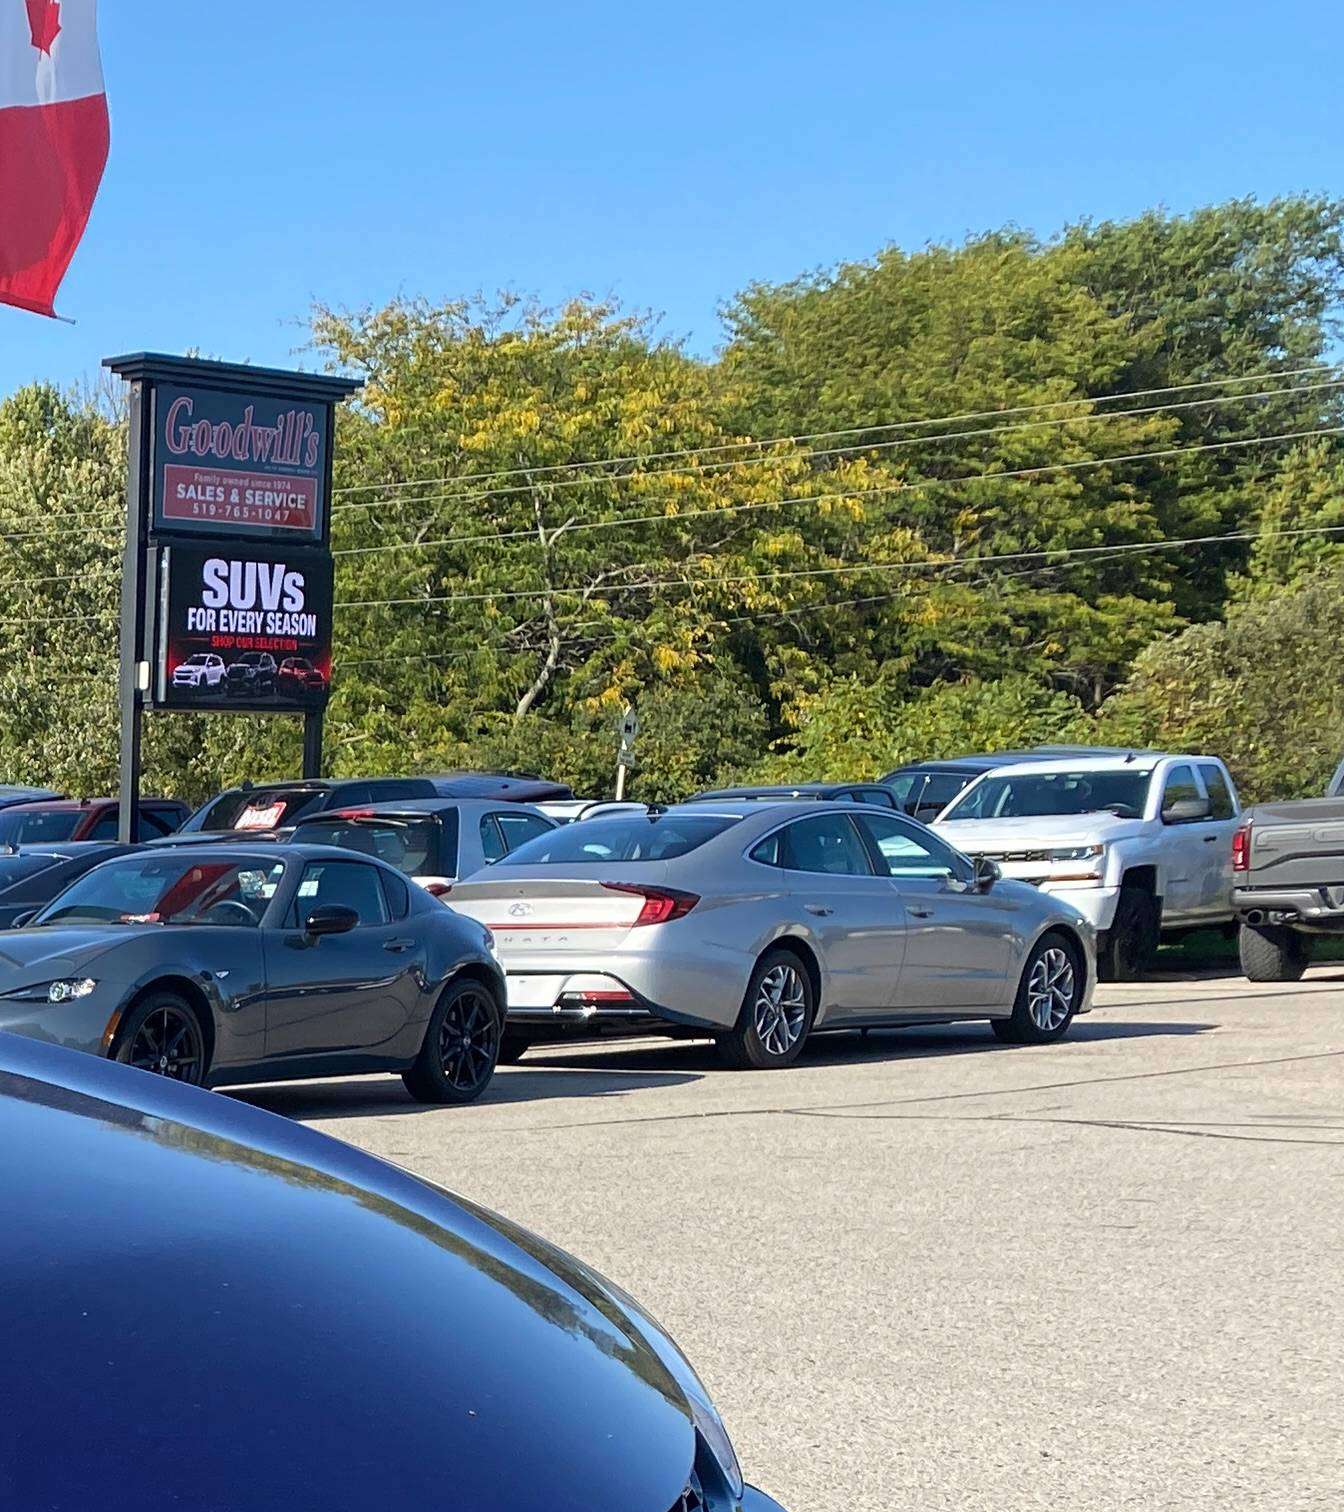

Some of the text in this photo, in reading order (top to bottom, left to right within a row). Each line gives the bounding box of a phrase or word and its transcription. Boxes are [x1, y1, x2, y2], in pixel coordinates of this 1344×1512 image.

[165, 396, 320, 468] Goodwill's
[194, 473, 220, 487] Family
[222, 476, 250, 489] owned
[251, 478, 273, 490] since
[176, 483, 306, 510] SALES & SERVICE
[192, 504, 290, 523] 519-765-1047
[202, 558, 305, 612] SUVs
[187, 608, 316, 637] FOR EVERY SEASON
[210, 634, 298, 651] SHOP OUR SELECTION
